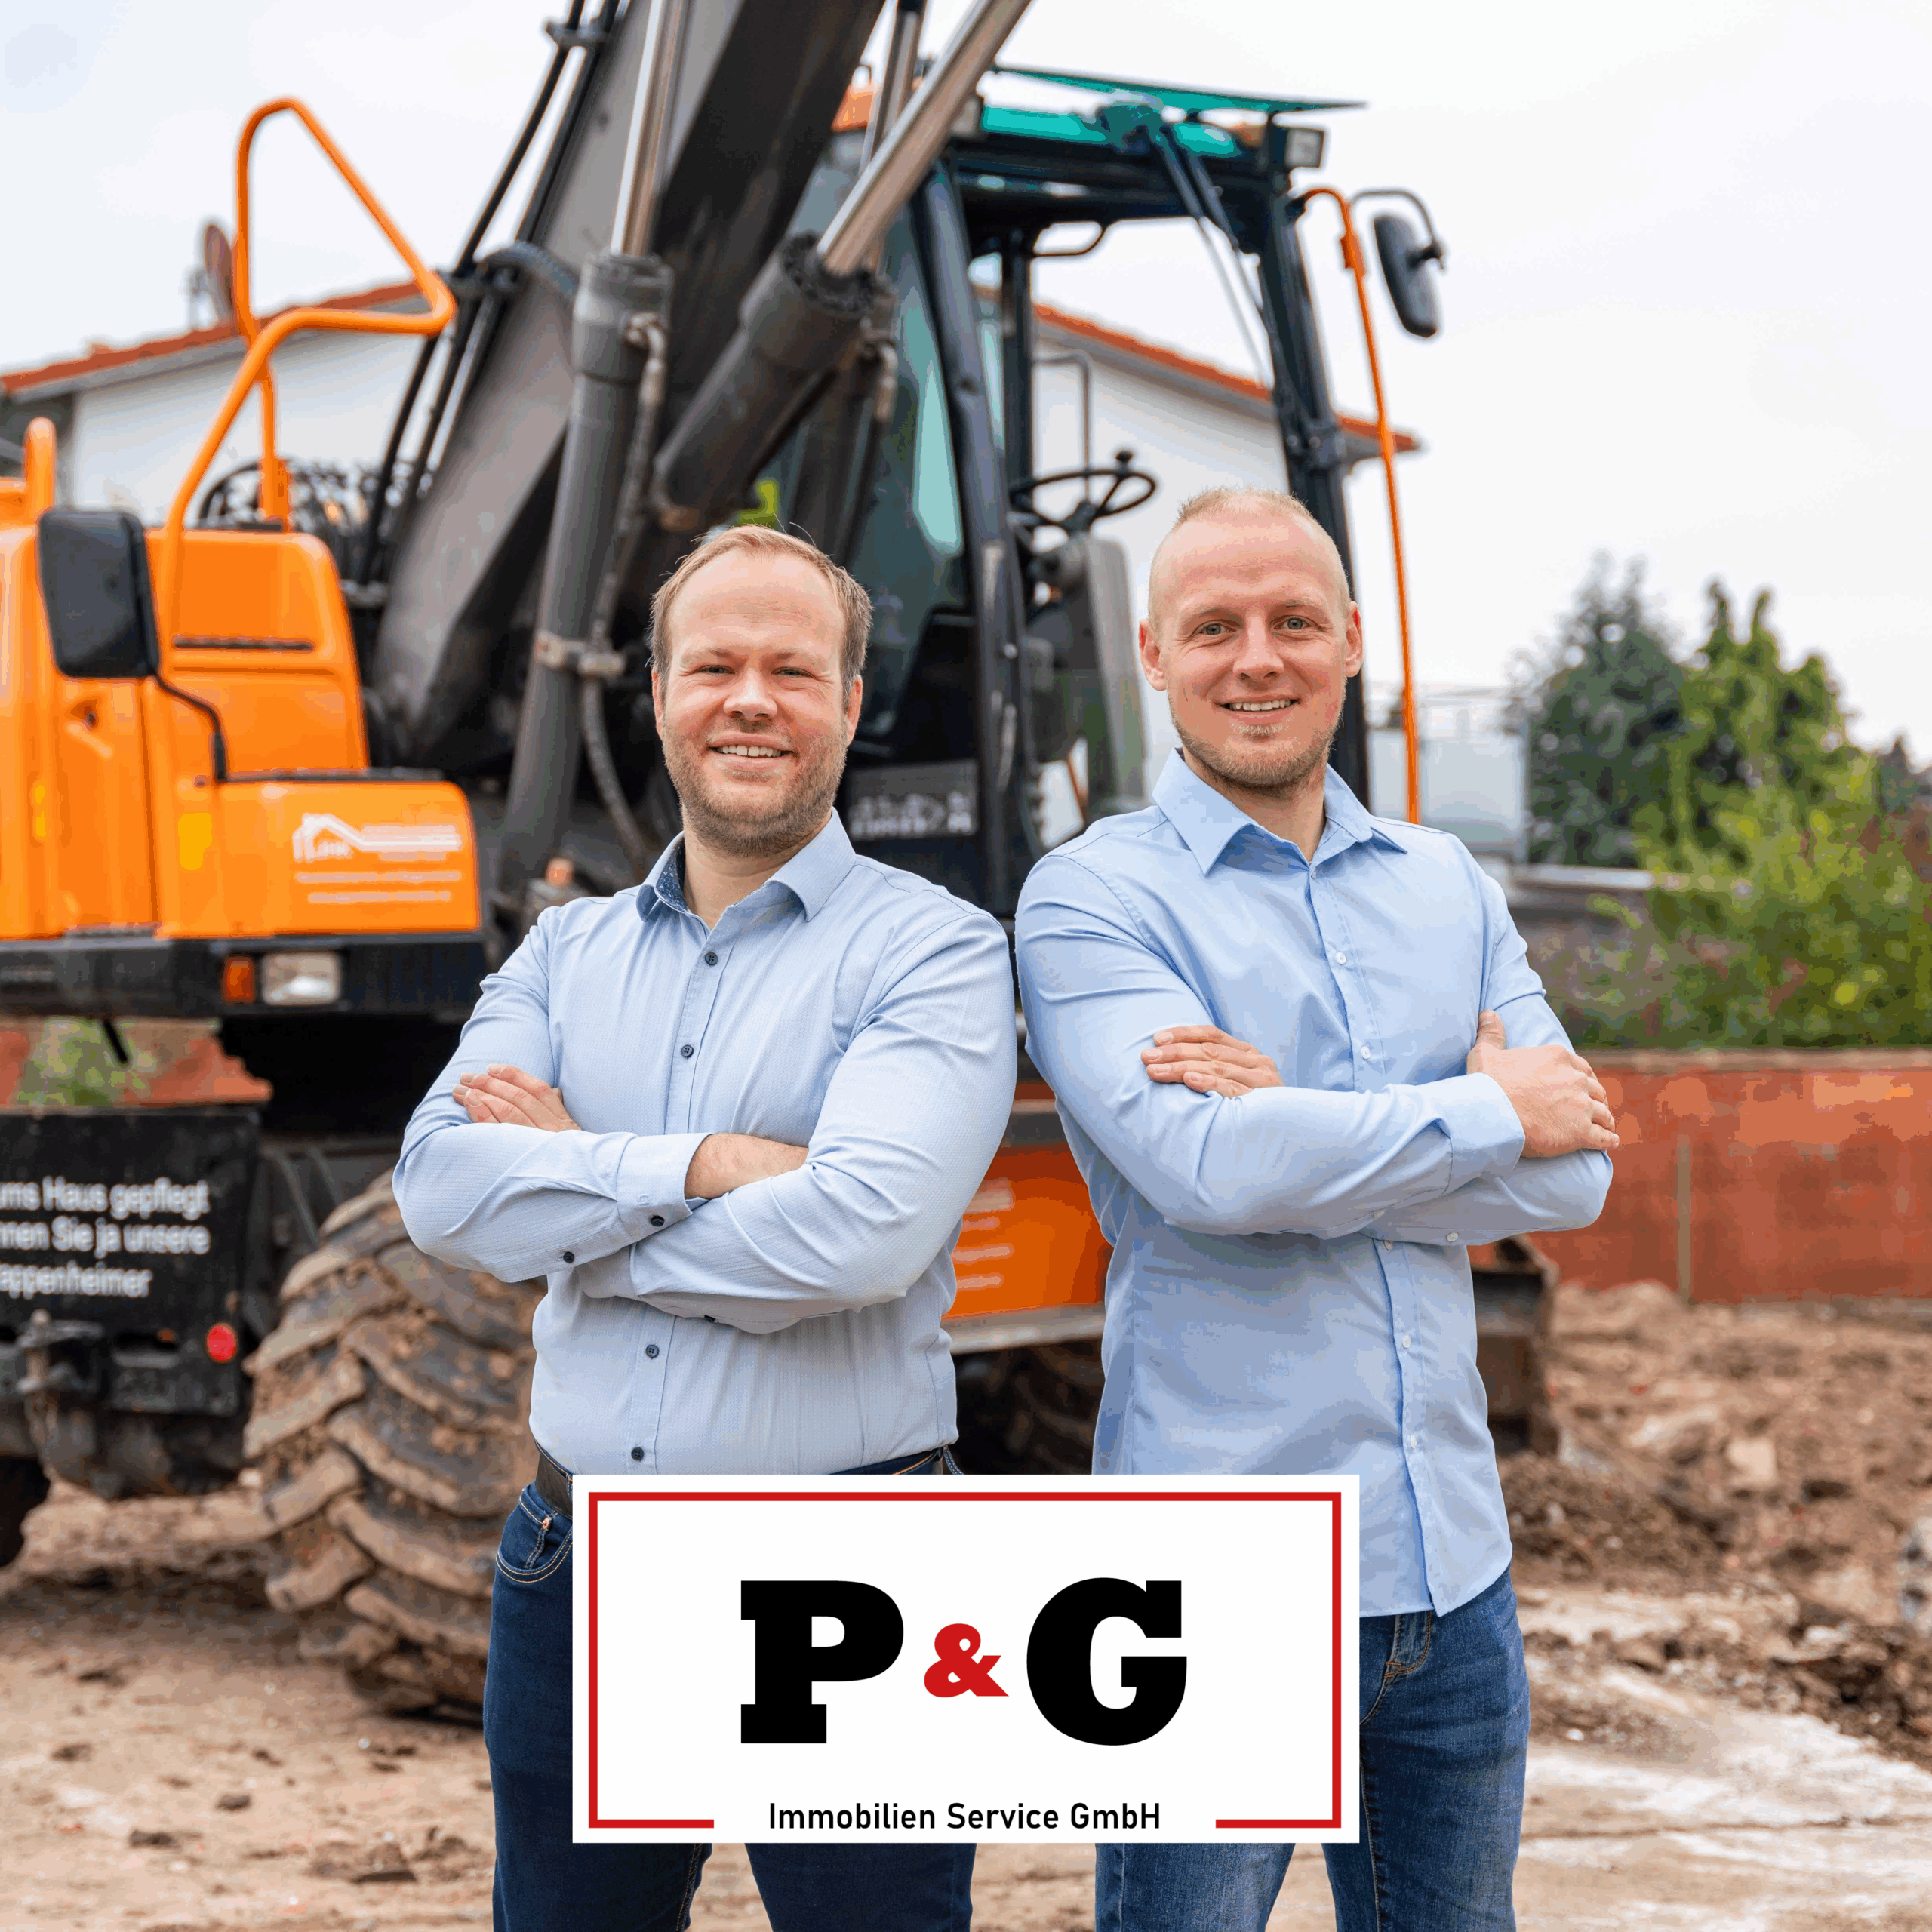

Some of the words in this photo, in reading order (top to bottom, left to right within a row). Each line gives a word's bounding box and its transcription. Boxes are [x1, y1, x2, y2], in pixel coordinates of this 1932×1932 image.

[43, 1176, 108, 1212] Haus
[111, 1177, 210, 1220] gepflegt
[52, 1216, 94, 1251] Sie
[94, 1217, 121, 1258] ja
[123, 1224, 210, 1254] unsere
